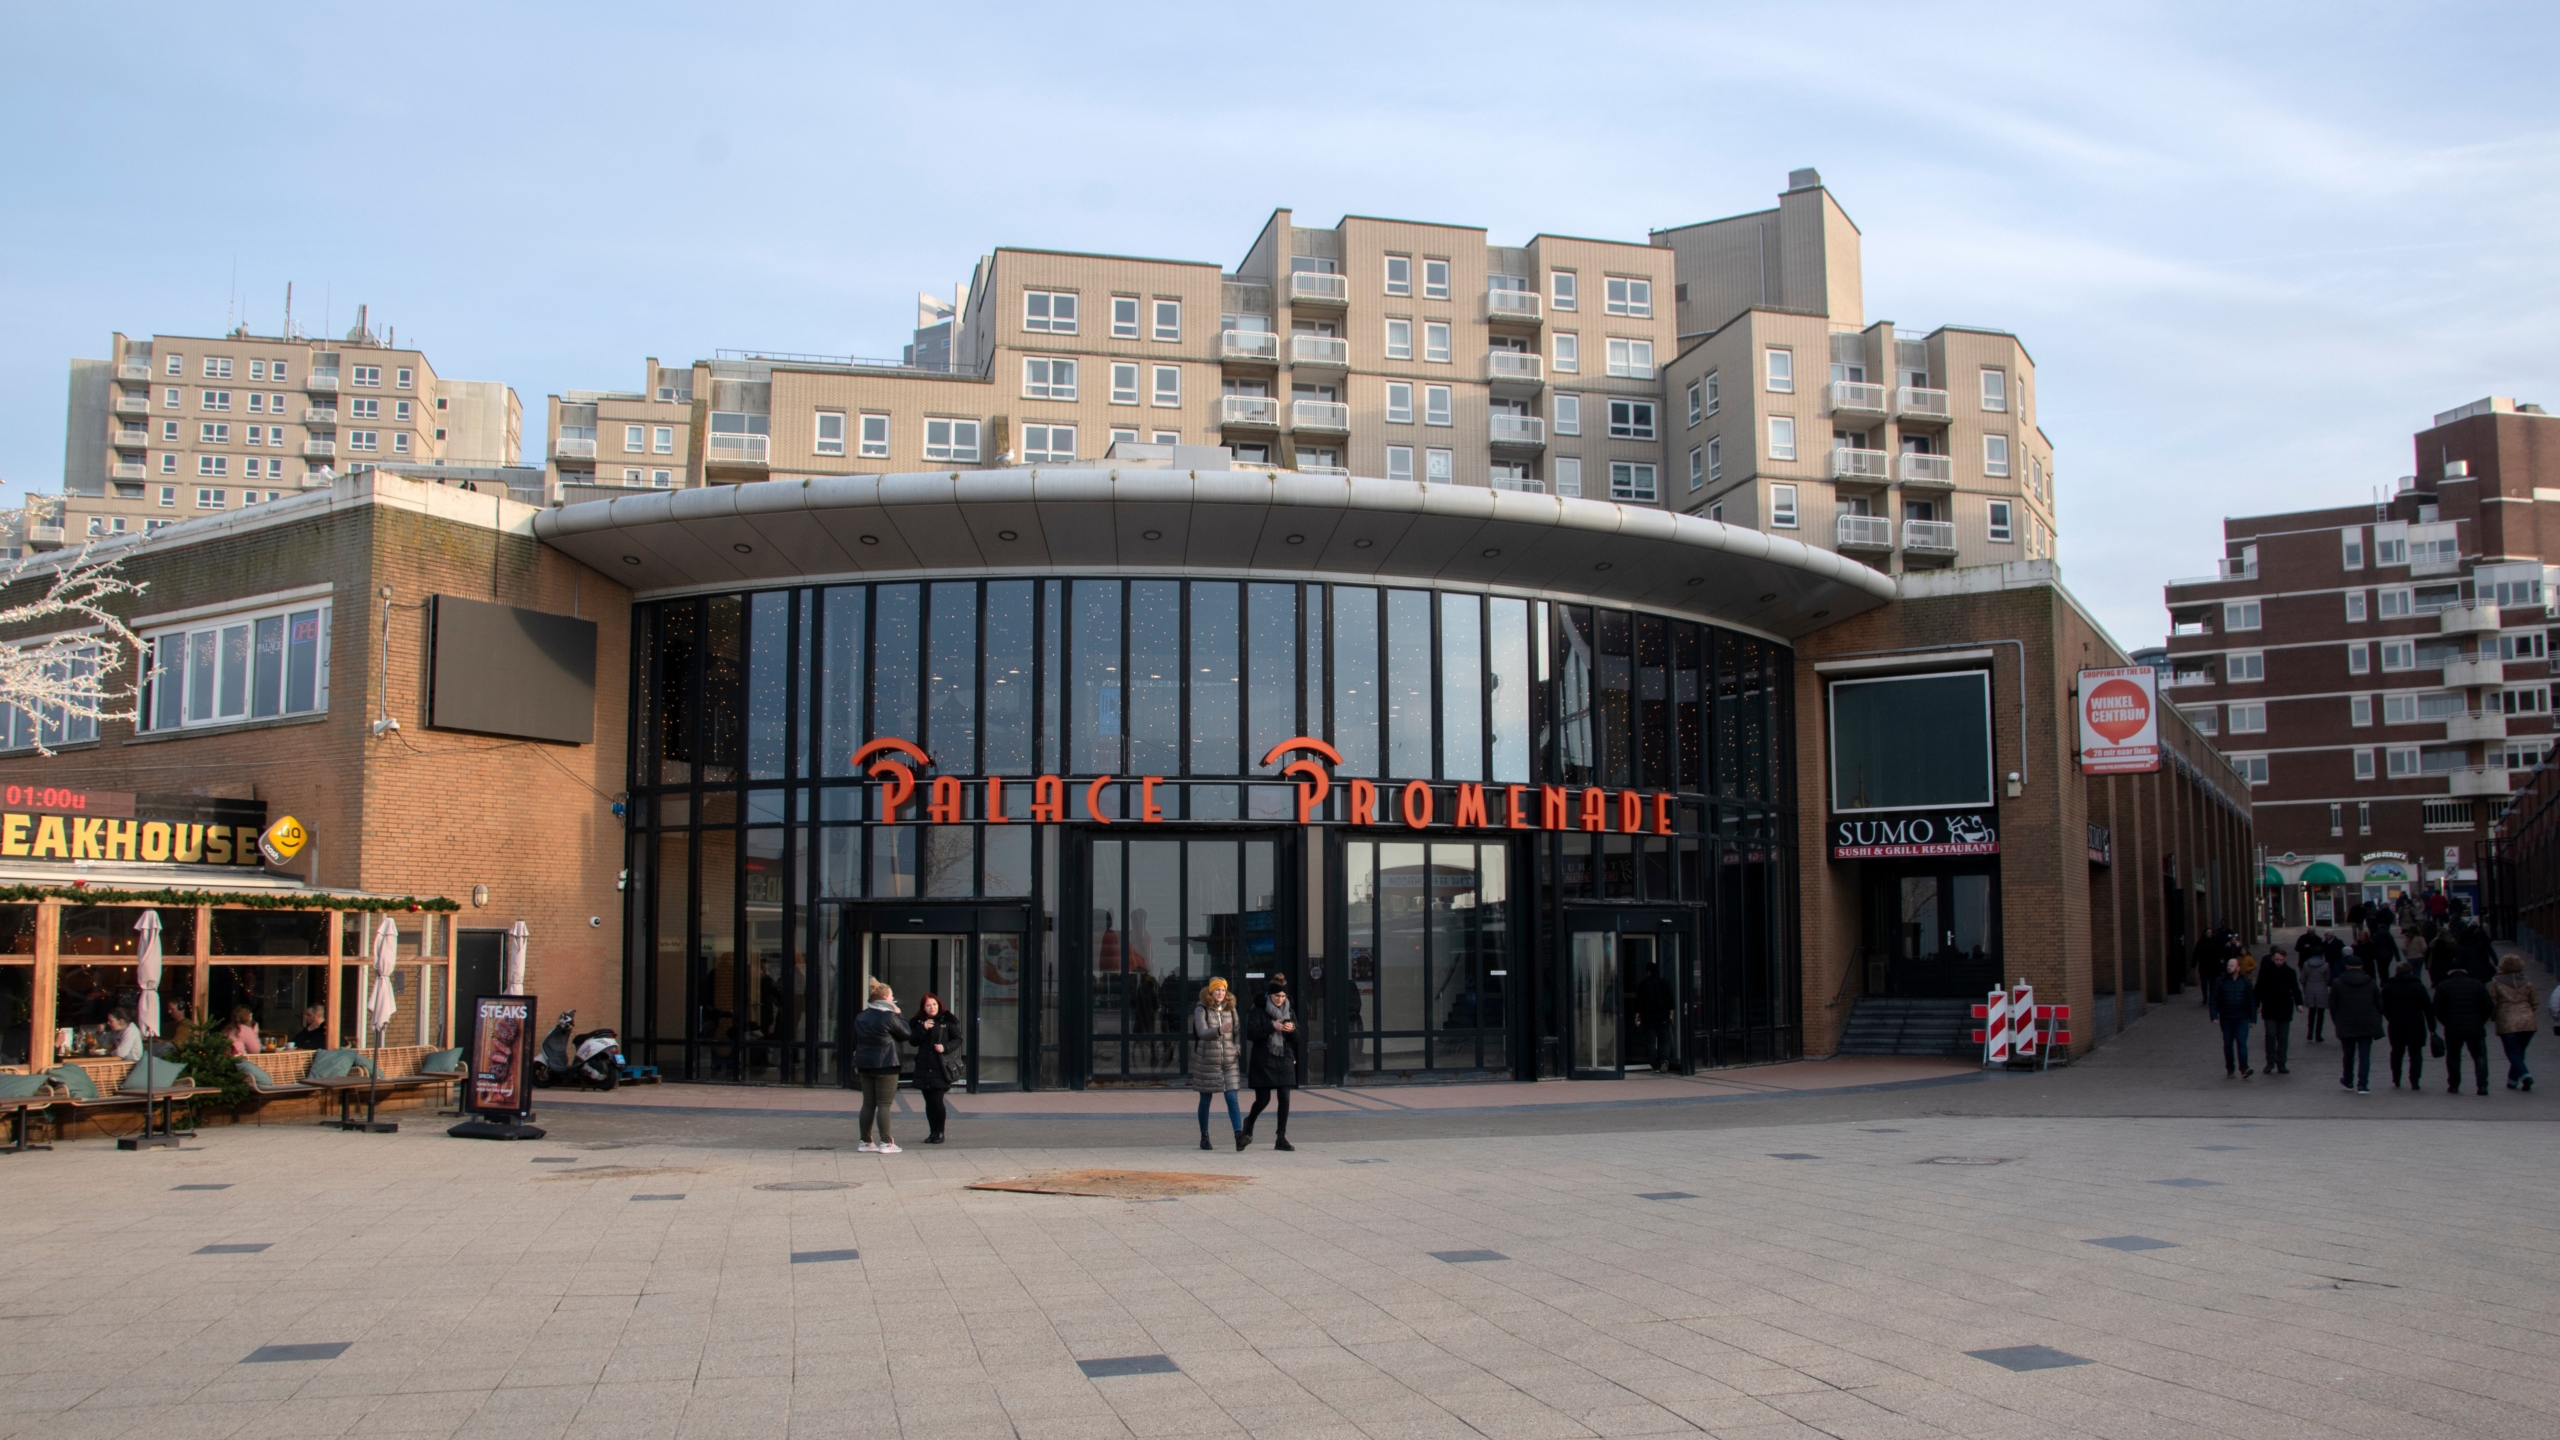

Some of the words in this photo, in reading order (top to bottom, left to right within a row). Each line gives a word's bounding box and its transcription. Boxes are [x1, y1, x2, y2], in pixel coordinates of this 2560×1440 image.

[2082, 670, 2116, 679] SHOPPING
[2090, 696, 2134, 710] WINKEL
[2091, 708, 2146, 722] CENTRUM
[2093, 749, 2102, 757] 20
[2116, 748, 2133, 756] naar
[2134, 747, 2151, 755] links
[6, 785, 86, 809] 01:00u
[868, 759, 1164, 825] PALACE
[1283, 759, 1673, 836] PROMENADE
[1, 813, 259, 865] EAKHOUSE
[1838, 818, 1934, 846] SUMO
[264, 844, 279, 860] cash
[1838, 846, 1872, 857] SUSHI
[1873, 846, 1884, 855] &
[1885, 846, 1919, 855] GRILL
[1921, 843, 1995, 854] RESTAURANT
[480, 1004, 528, 1019] STEAKS
